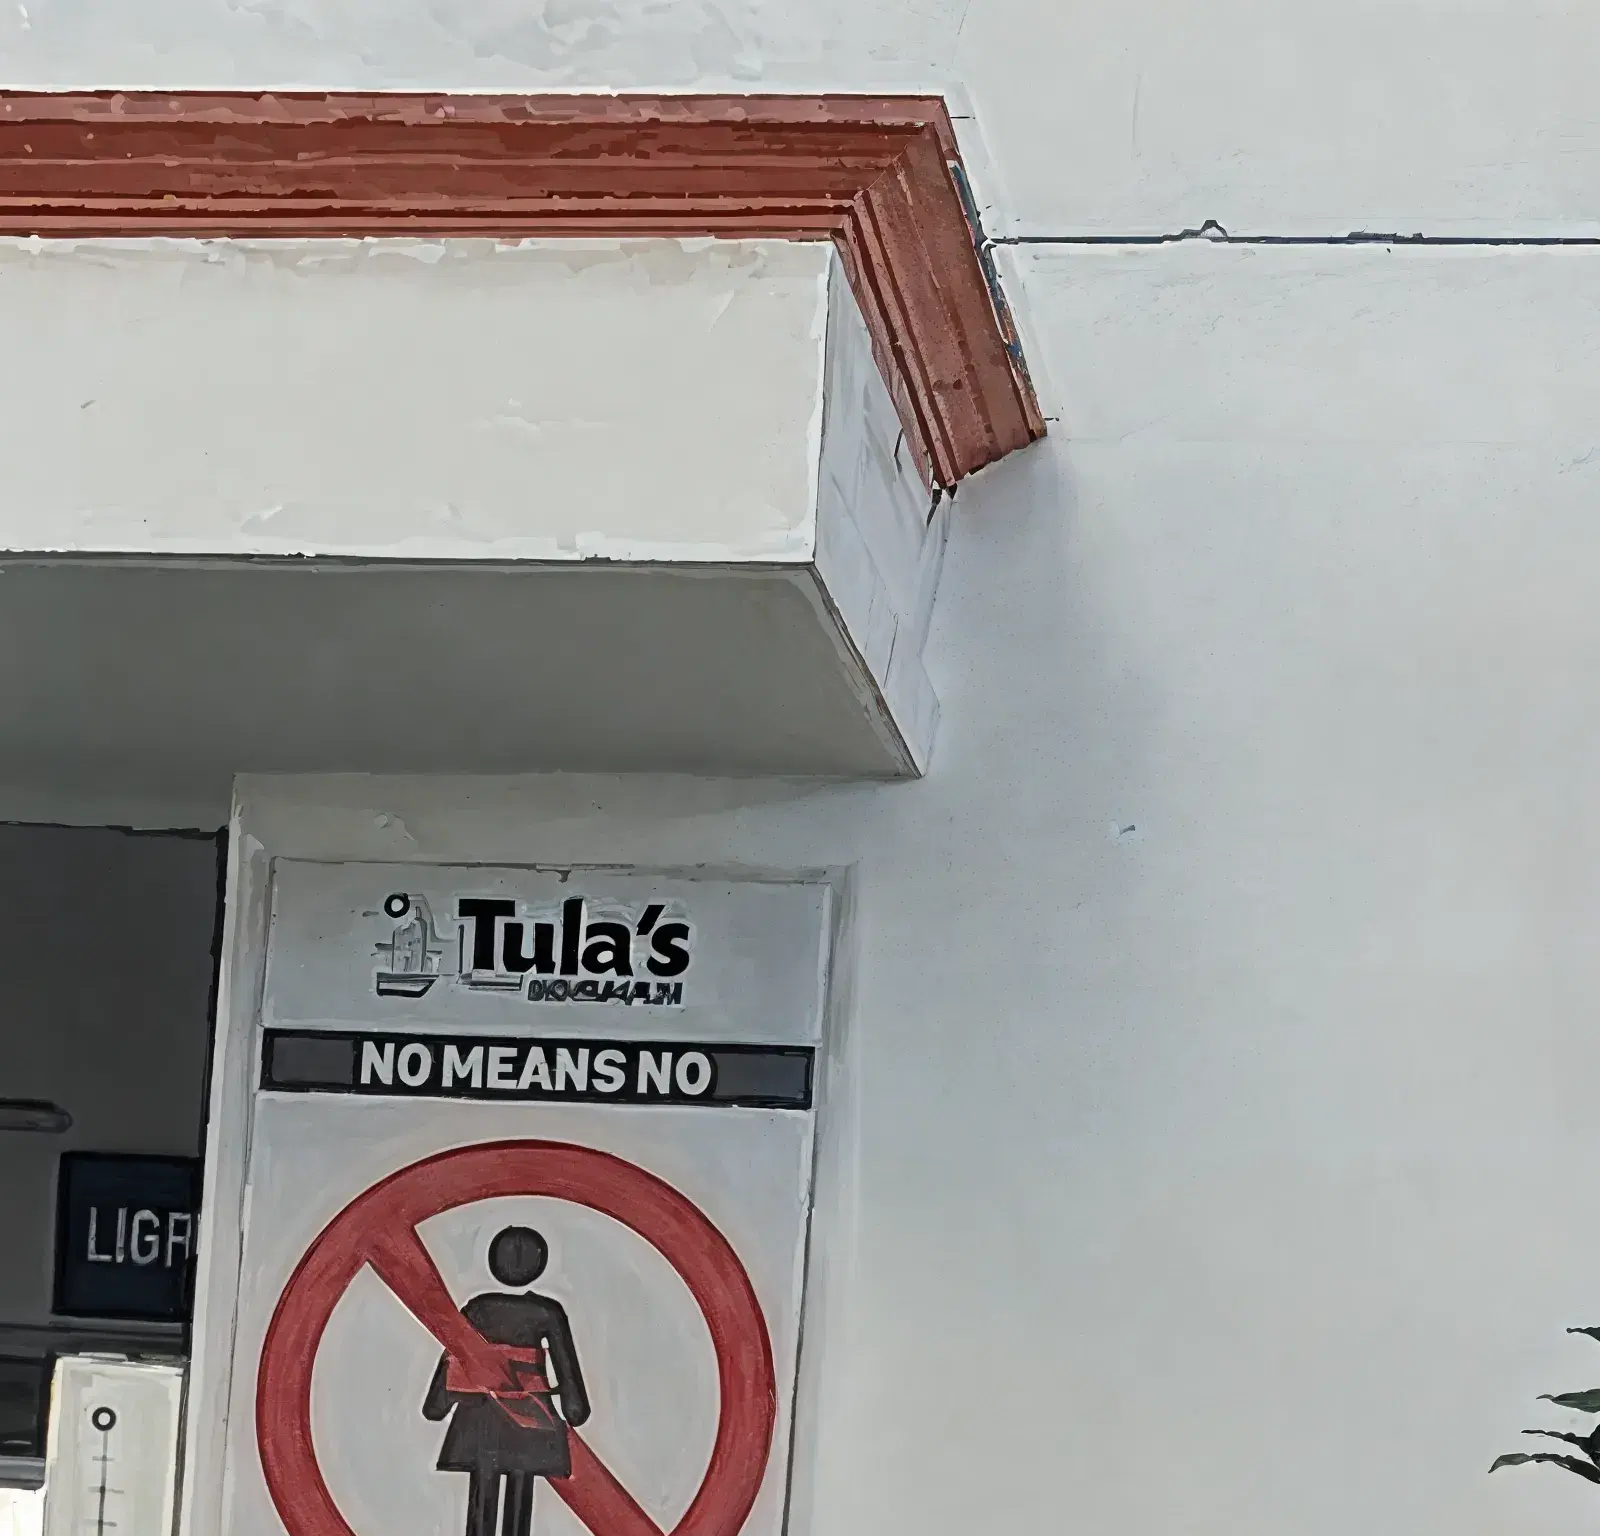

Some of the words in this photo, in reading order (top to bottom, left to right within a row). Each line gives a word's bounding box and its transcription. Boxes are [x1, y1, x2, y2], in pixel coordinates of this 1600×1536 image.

[459, 897, 691, 977] Tula's
[360, 1041, 432, 1089] NO
[442, 1045, 627, 1094] MEANS
[636, 1050, 712, 1096] NO
